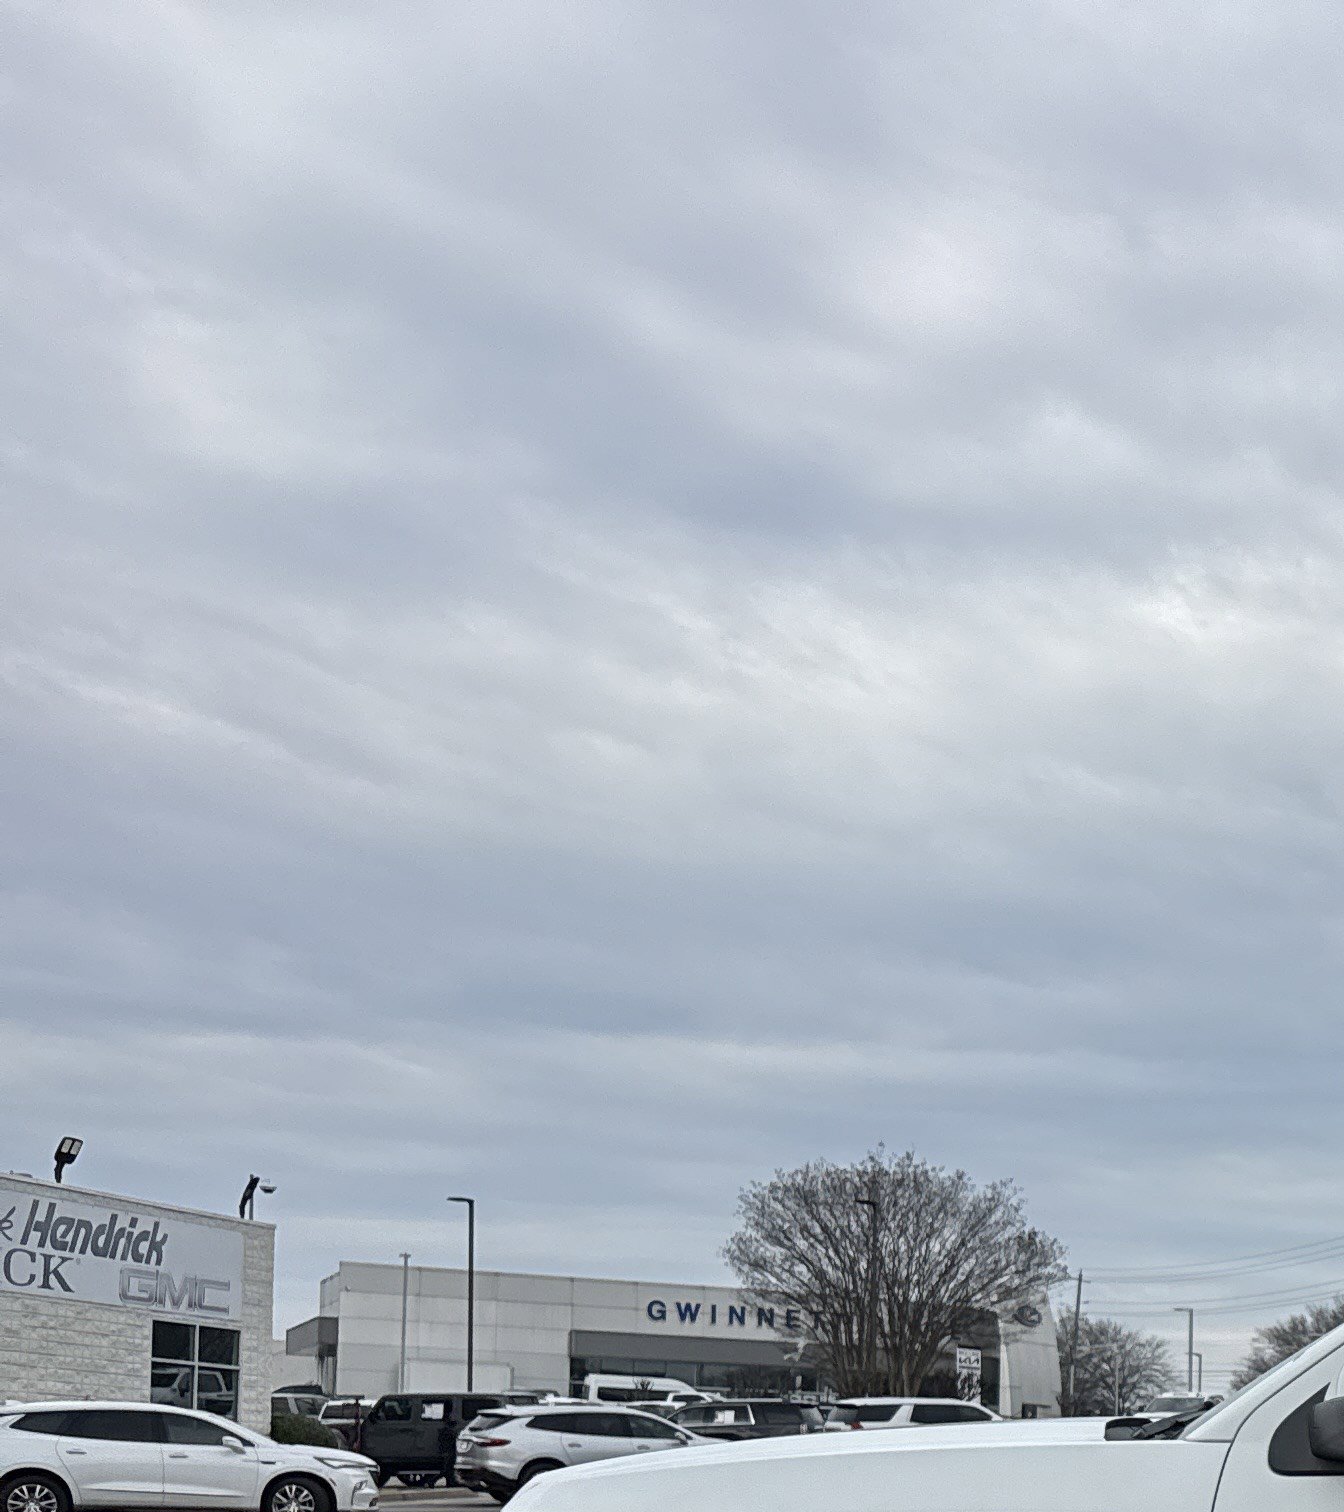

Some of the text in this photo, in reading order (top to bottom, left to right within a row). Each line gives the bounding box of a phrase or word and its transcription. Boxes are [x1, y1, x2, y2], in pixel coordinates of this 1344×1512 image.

[20, 1199, 169, 1266] Hendrick
[0, 1247, 75, 1293] CK
[119, 1266, 231, 1315] GMC
[646, 1299, 852, 1332] GWINNET
